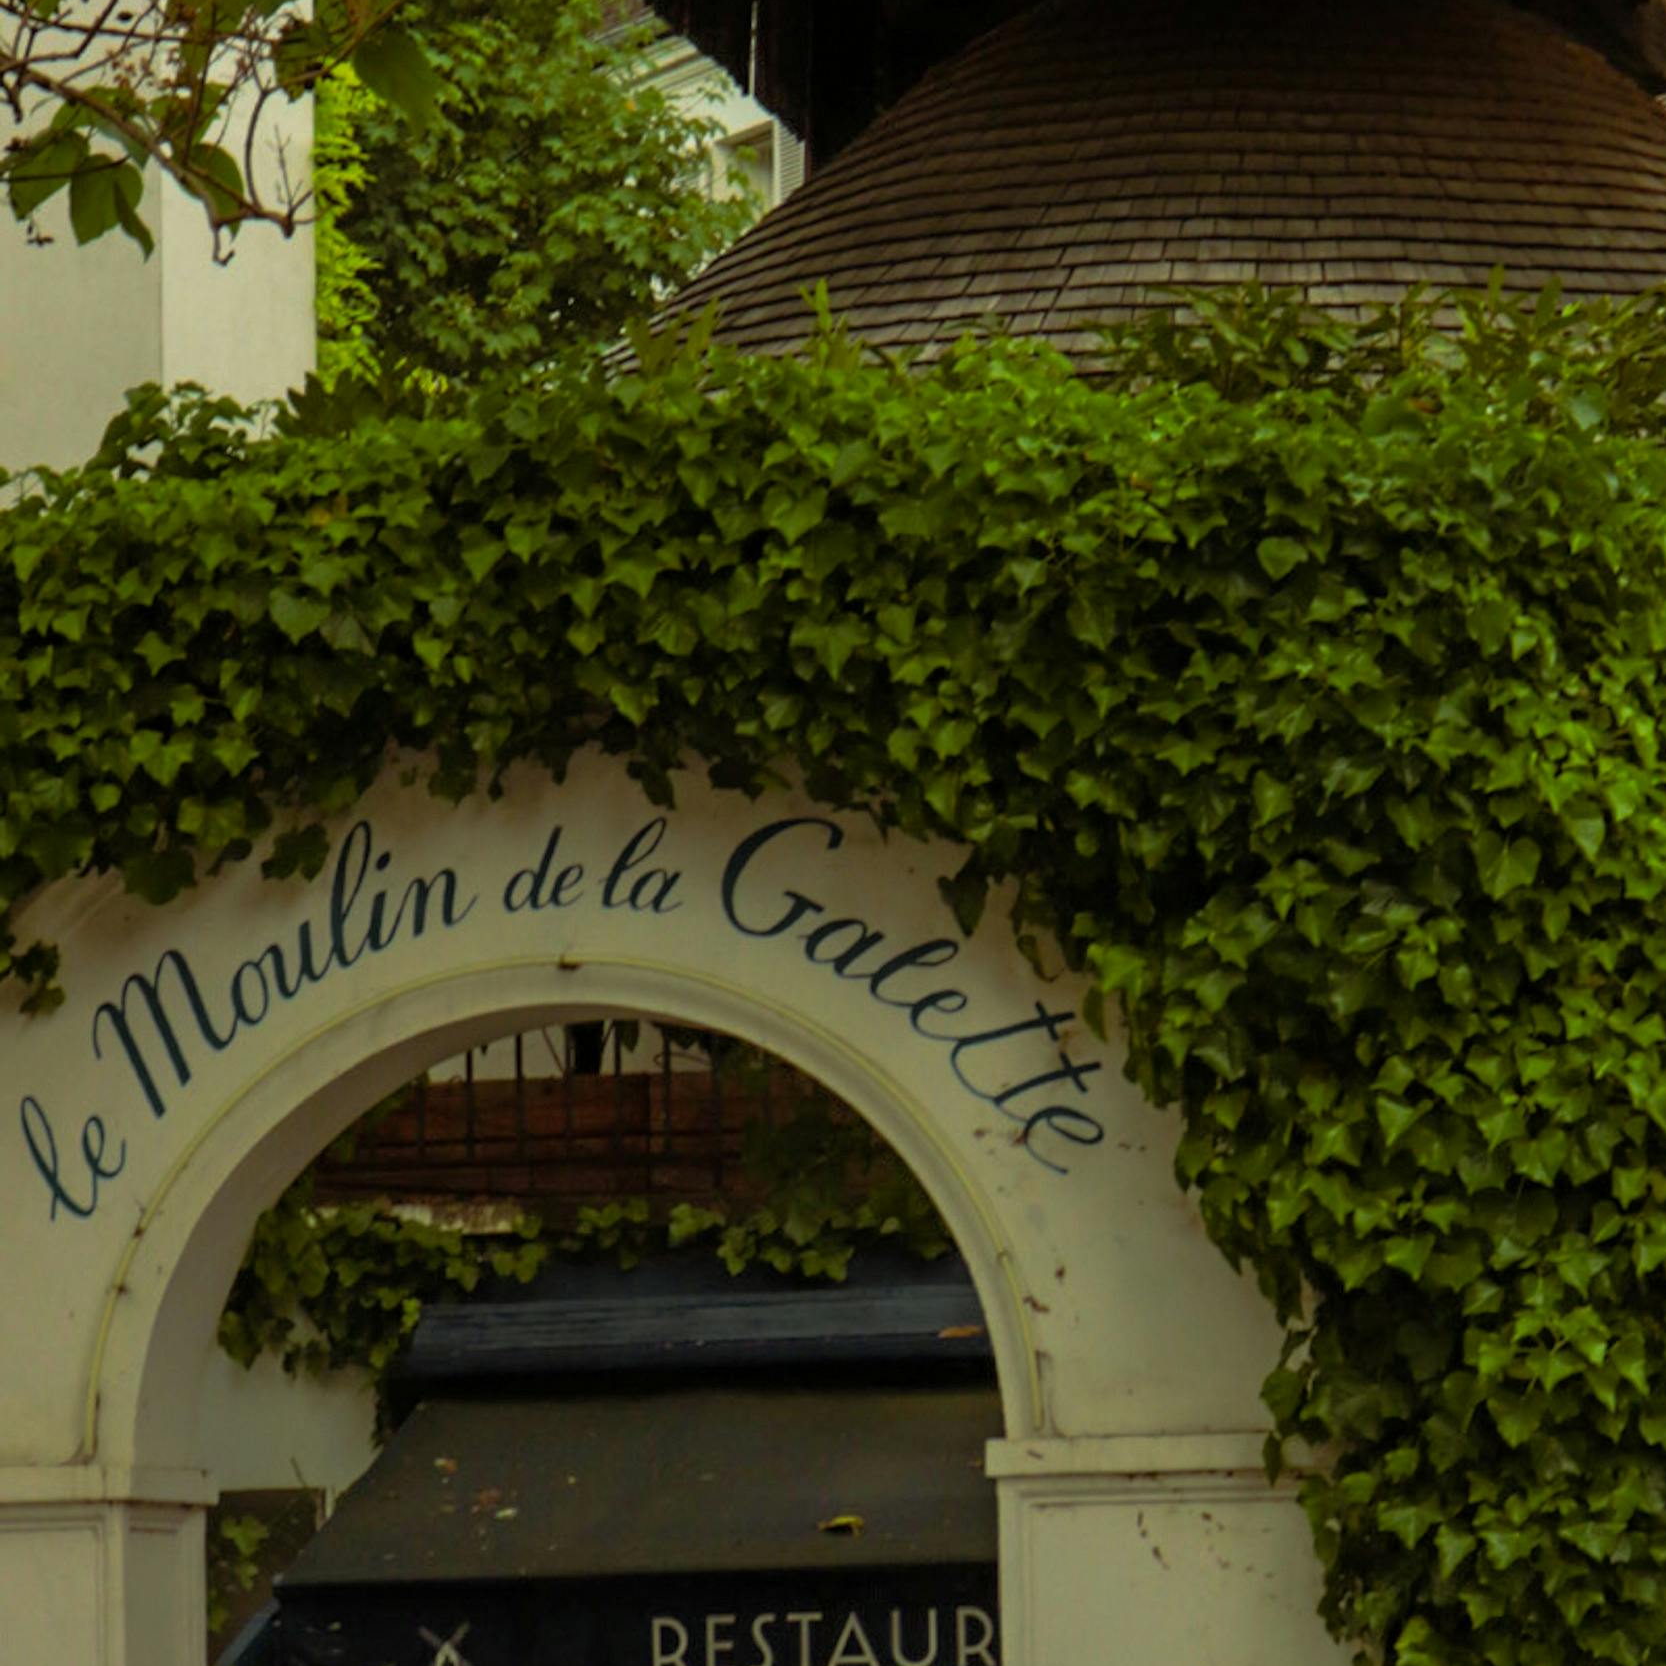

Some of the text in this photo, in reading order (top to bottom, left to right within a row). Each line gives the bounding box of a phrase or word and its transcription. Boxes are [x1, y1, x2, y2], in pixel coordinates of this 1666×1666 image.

[20, 817, 1105, 1221] le Moulin de la Galette
